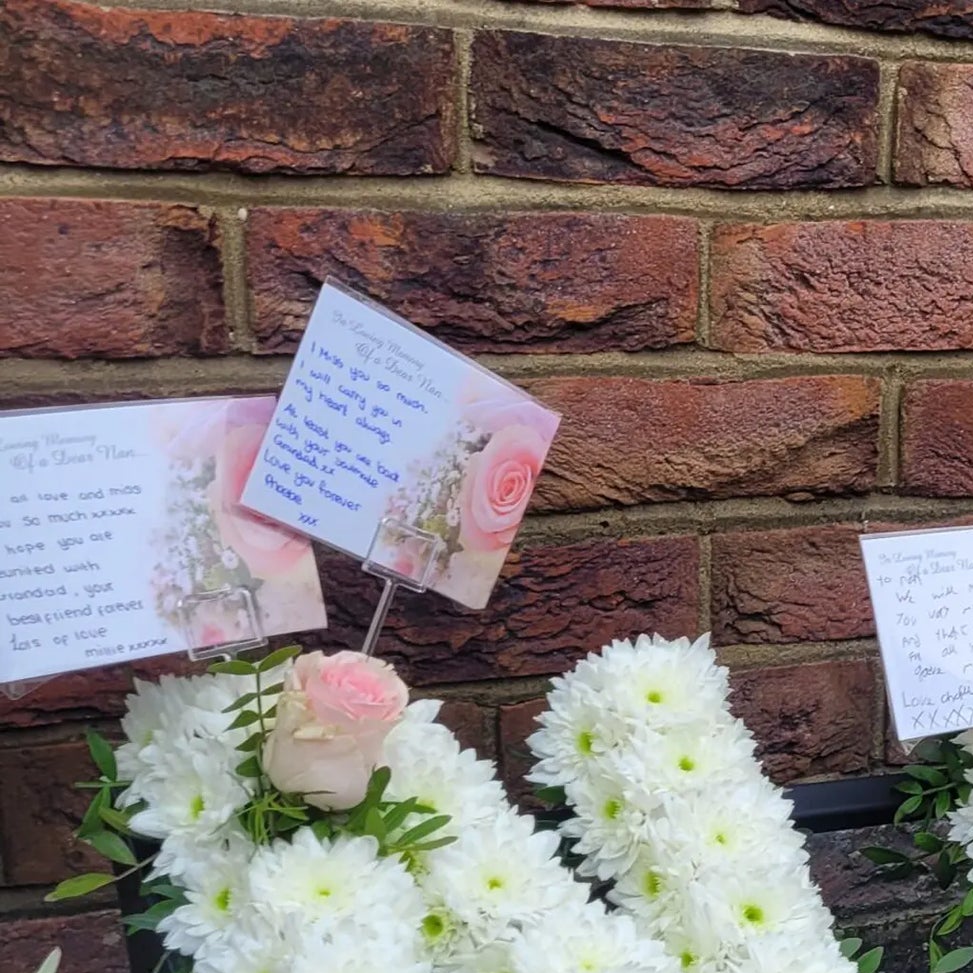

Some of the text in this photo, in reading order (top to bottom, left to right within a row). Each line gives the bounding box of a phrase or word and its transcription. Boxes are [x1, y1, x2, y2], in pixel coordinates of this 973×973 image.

[350, 366, 370, 382] you
[0, 440, 38, 452] oving
[293, 471, 315, 488] you
[37, 491, 68, 501] love
[78, 488, 105, 501] and
[48, 510, 88, 524] much
[5, 541, 45, 555] hope
[57, 536, 84, 551] you
[52, 634, 70, 647] of
